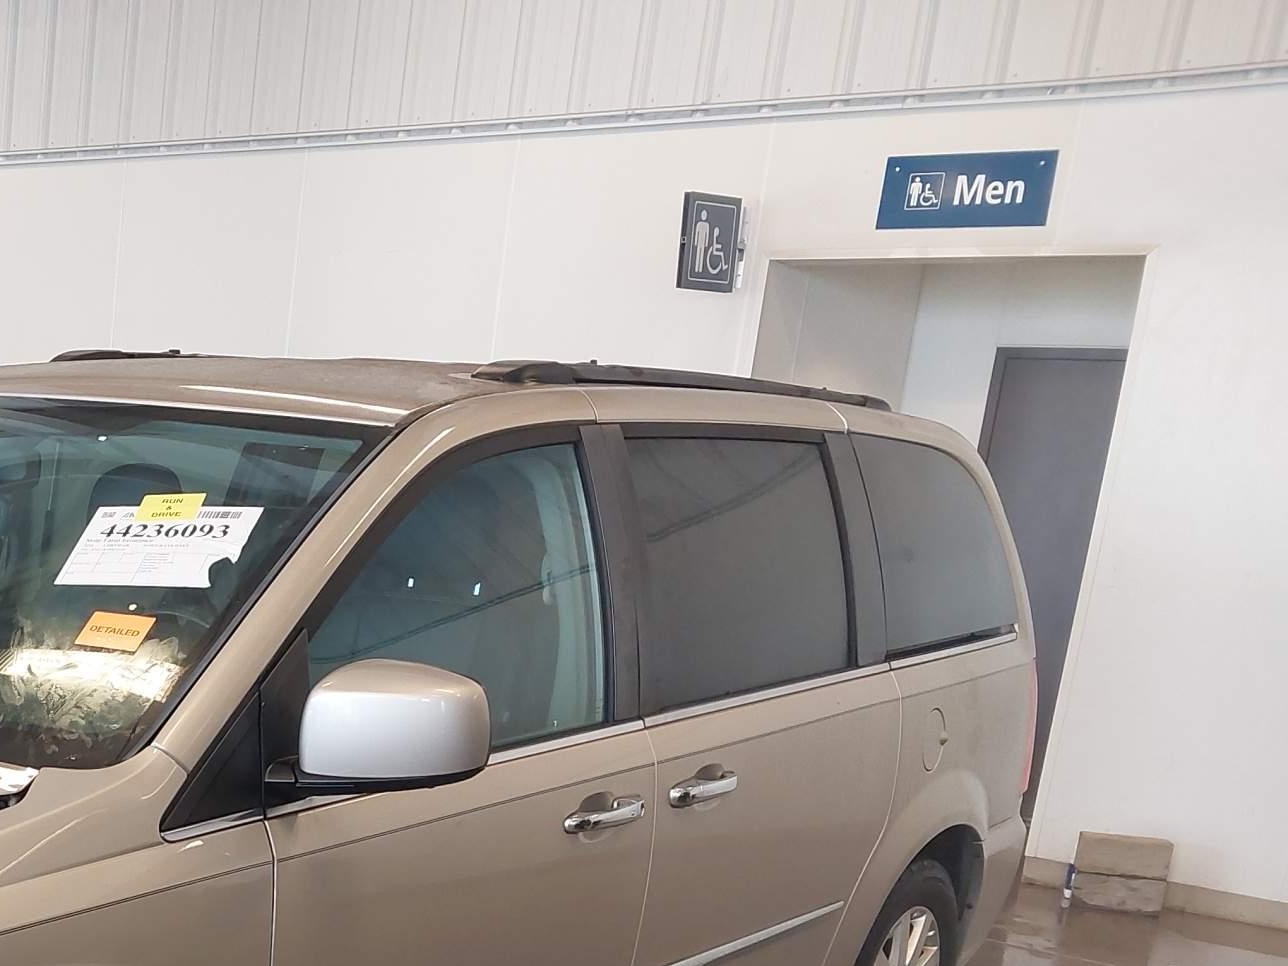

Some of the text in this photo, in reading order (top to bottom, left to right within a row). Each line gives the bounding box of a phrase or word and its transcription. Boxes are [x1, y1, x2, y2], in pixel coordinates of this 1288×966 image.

[952, 173, 1025, 206] Men
[100, 523, 231, 539] 44236093
[89, 624, 140, 637] DETAILED
